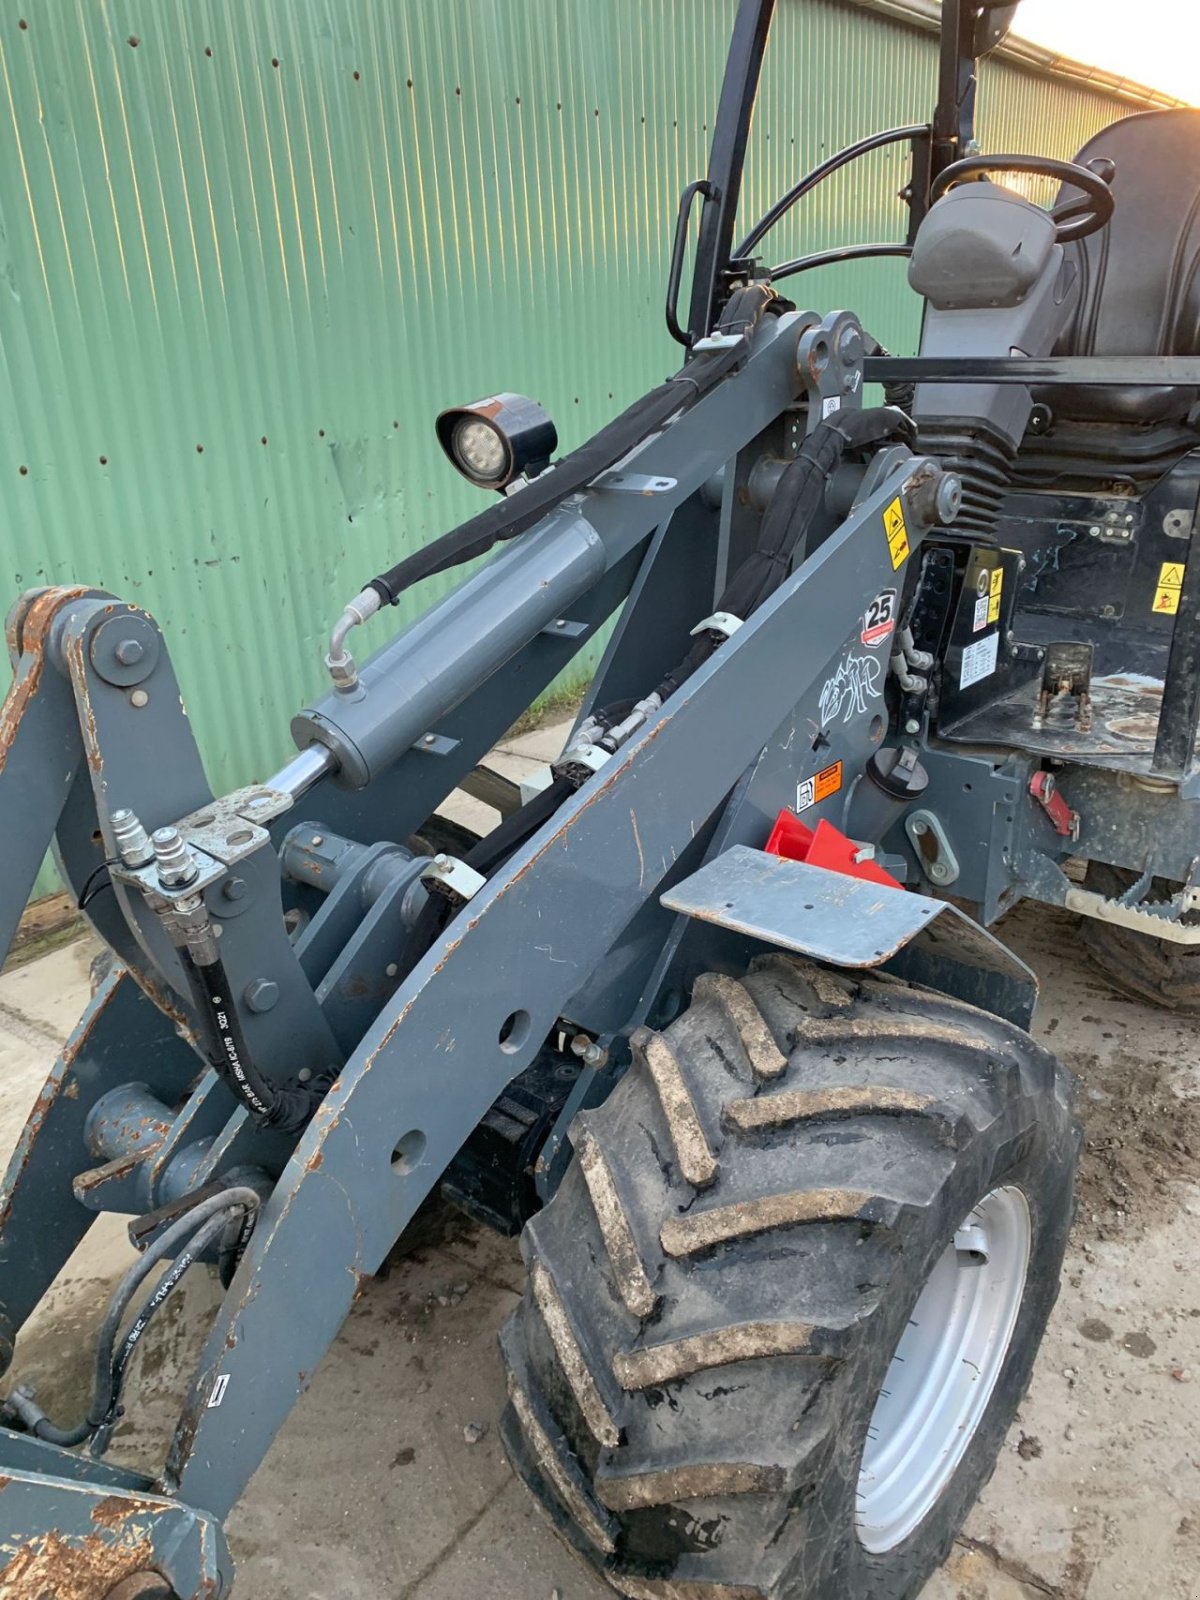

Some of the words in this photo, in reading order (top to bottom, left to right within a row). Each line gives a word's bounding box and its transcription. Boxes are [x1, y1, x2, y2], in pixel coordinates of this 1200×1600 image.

[868, 596, 890, 629] 25
[232, 1060, 246, 1082] MSHA
[241, 1083, 255, 1098] BAR
